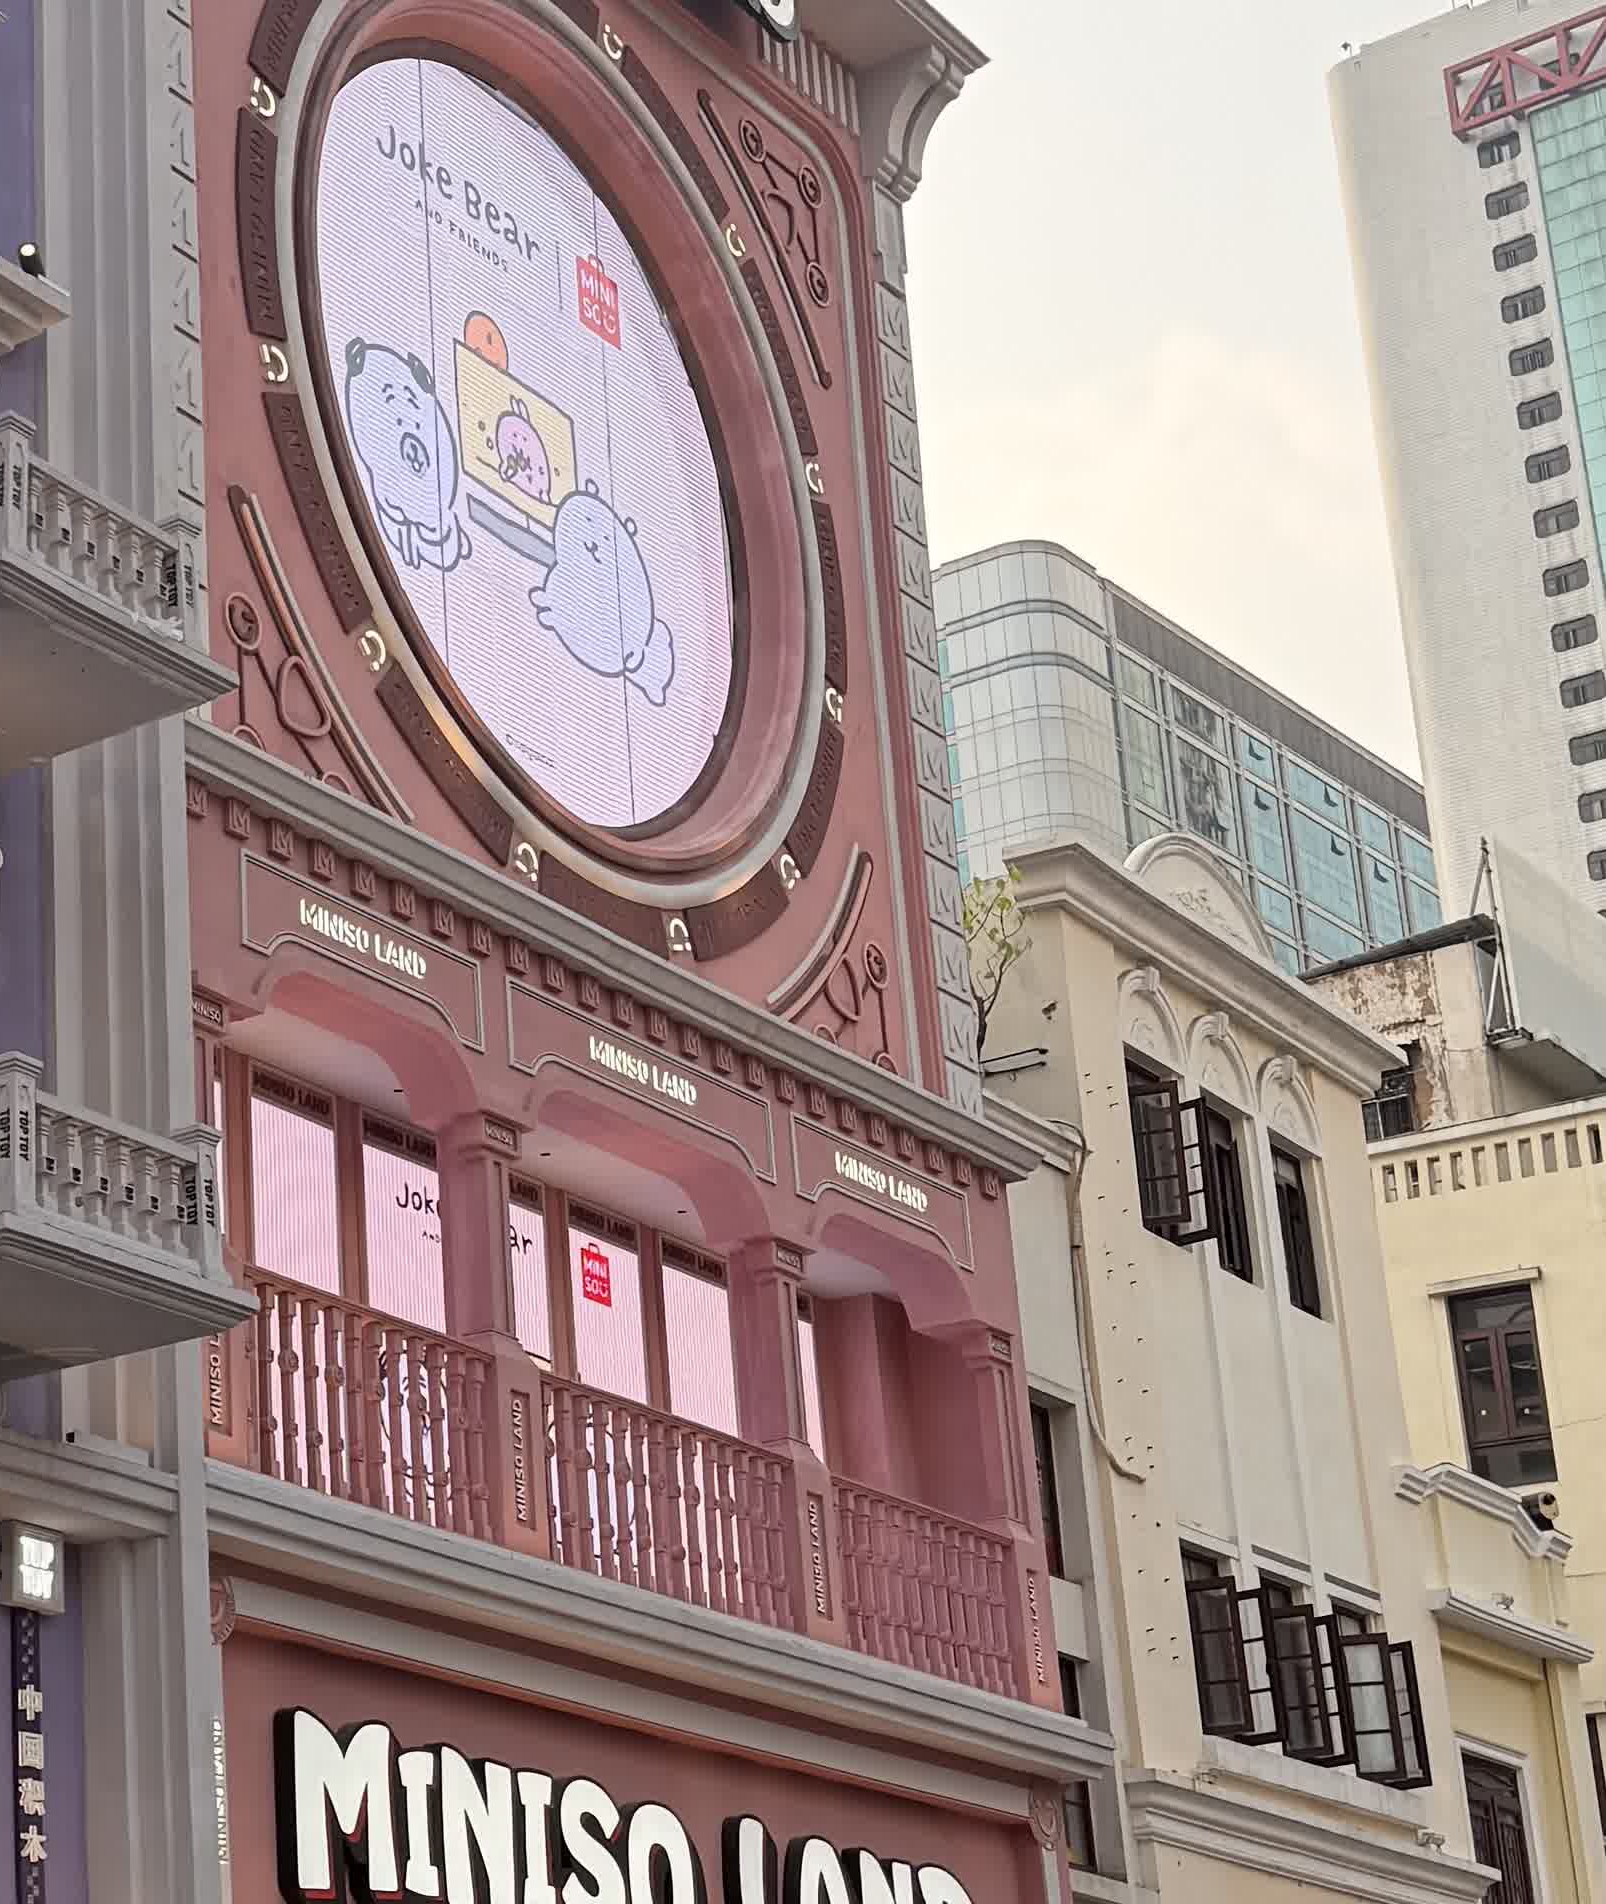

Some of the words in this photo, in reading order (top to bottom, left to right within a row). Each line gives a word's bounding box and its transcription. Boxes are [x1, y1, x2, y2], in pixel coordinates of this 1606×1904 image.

[375, 125, 454, 201] Joke
[464, 181, 541, 261] Bear
[448, 220, 510, 274] FRIENDS
[580, 267, 619, 312] MINI
[299, 898, 372, 953] MINISO
[374, 933, 427, 980] LAND
[589, 1036, 650, 1084] MINISO
[653, 1064, 697, 1106] LAND
[0, 1108, 10, 1135] TOP
[0, 1134, 10, 1160] TOY
[19, 1110, 29, 1137] TOP
[19, 1135, 30, 1161] TOY
[203, 1178, 212, 1205] TOP
[834, 1151, 887, 1193] MINISO
[888, 1175, 929, 1213] LAND
[203, 1203, 213, 1227] TOY
[509, 1224, 533, 1255] ar
[209, 1354, 223, 1425] MINISO
[513, 1399, 523, 1449] LAND
[514, 1455, 527, 1521] MINISO
[813, 1553, 826, 1615] MINISO
[16, 1684, 47, 1864] 中国积木
